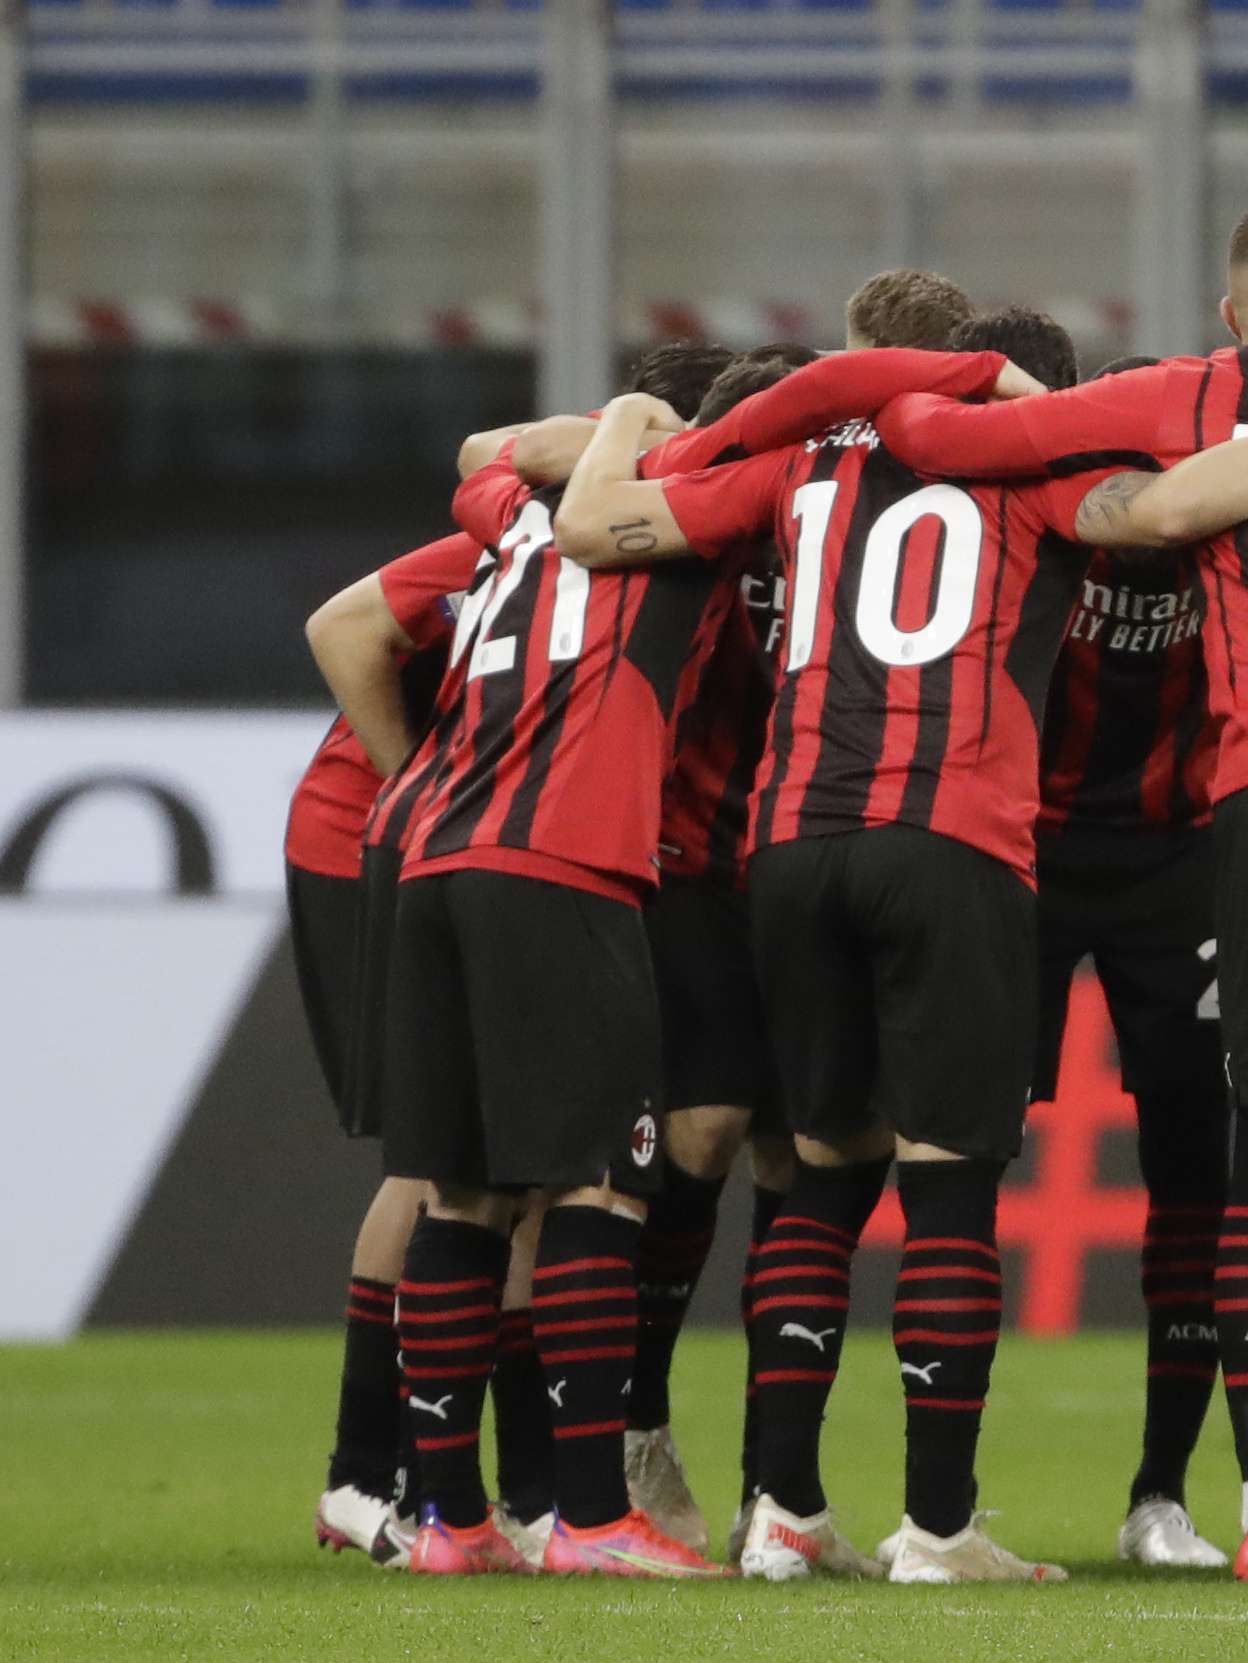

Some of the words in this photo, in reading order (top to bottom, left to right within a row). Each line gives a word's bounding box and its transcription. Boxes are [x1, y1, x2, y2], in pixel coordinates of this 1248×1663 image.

[466, 499, 590, 684] 21
[608, 518, 658, 553] 10
[786, 480, 983, 673] 10
[1109, 609, 1200, 652] BETTER
